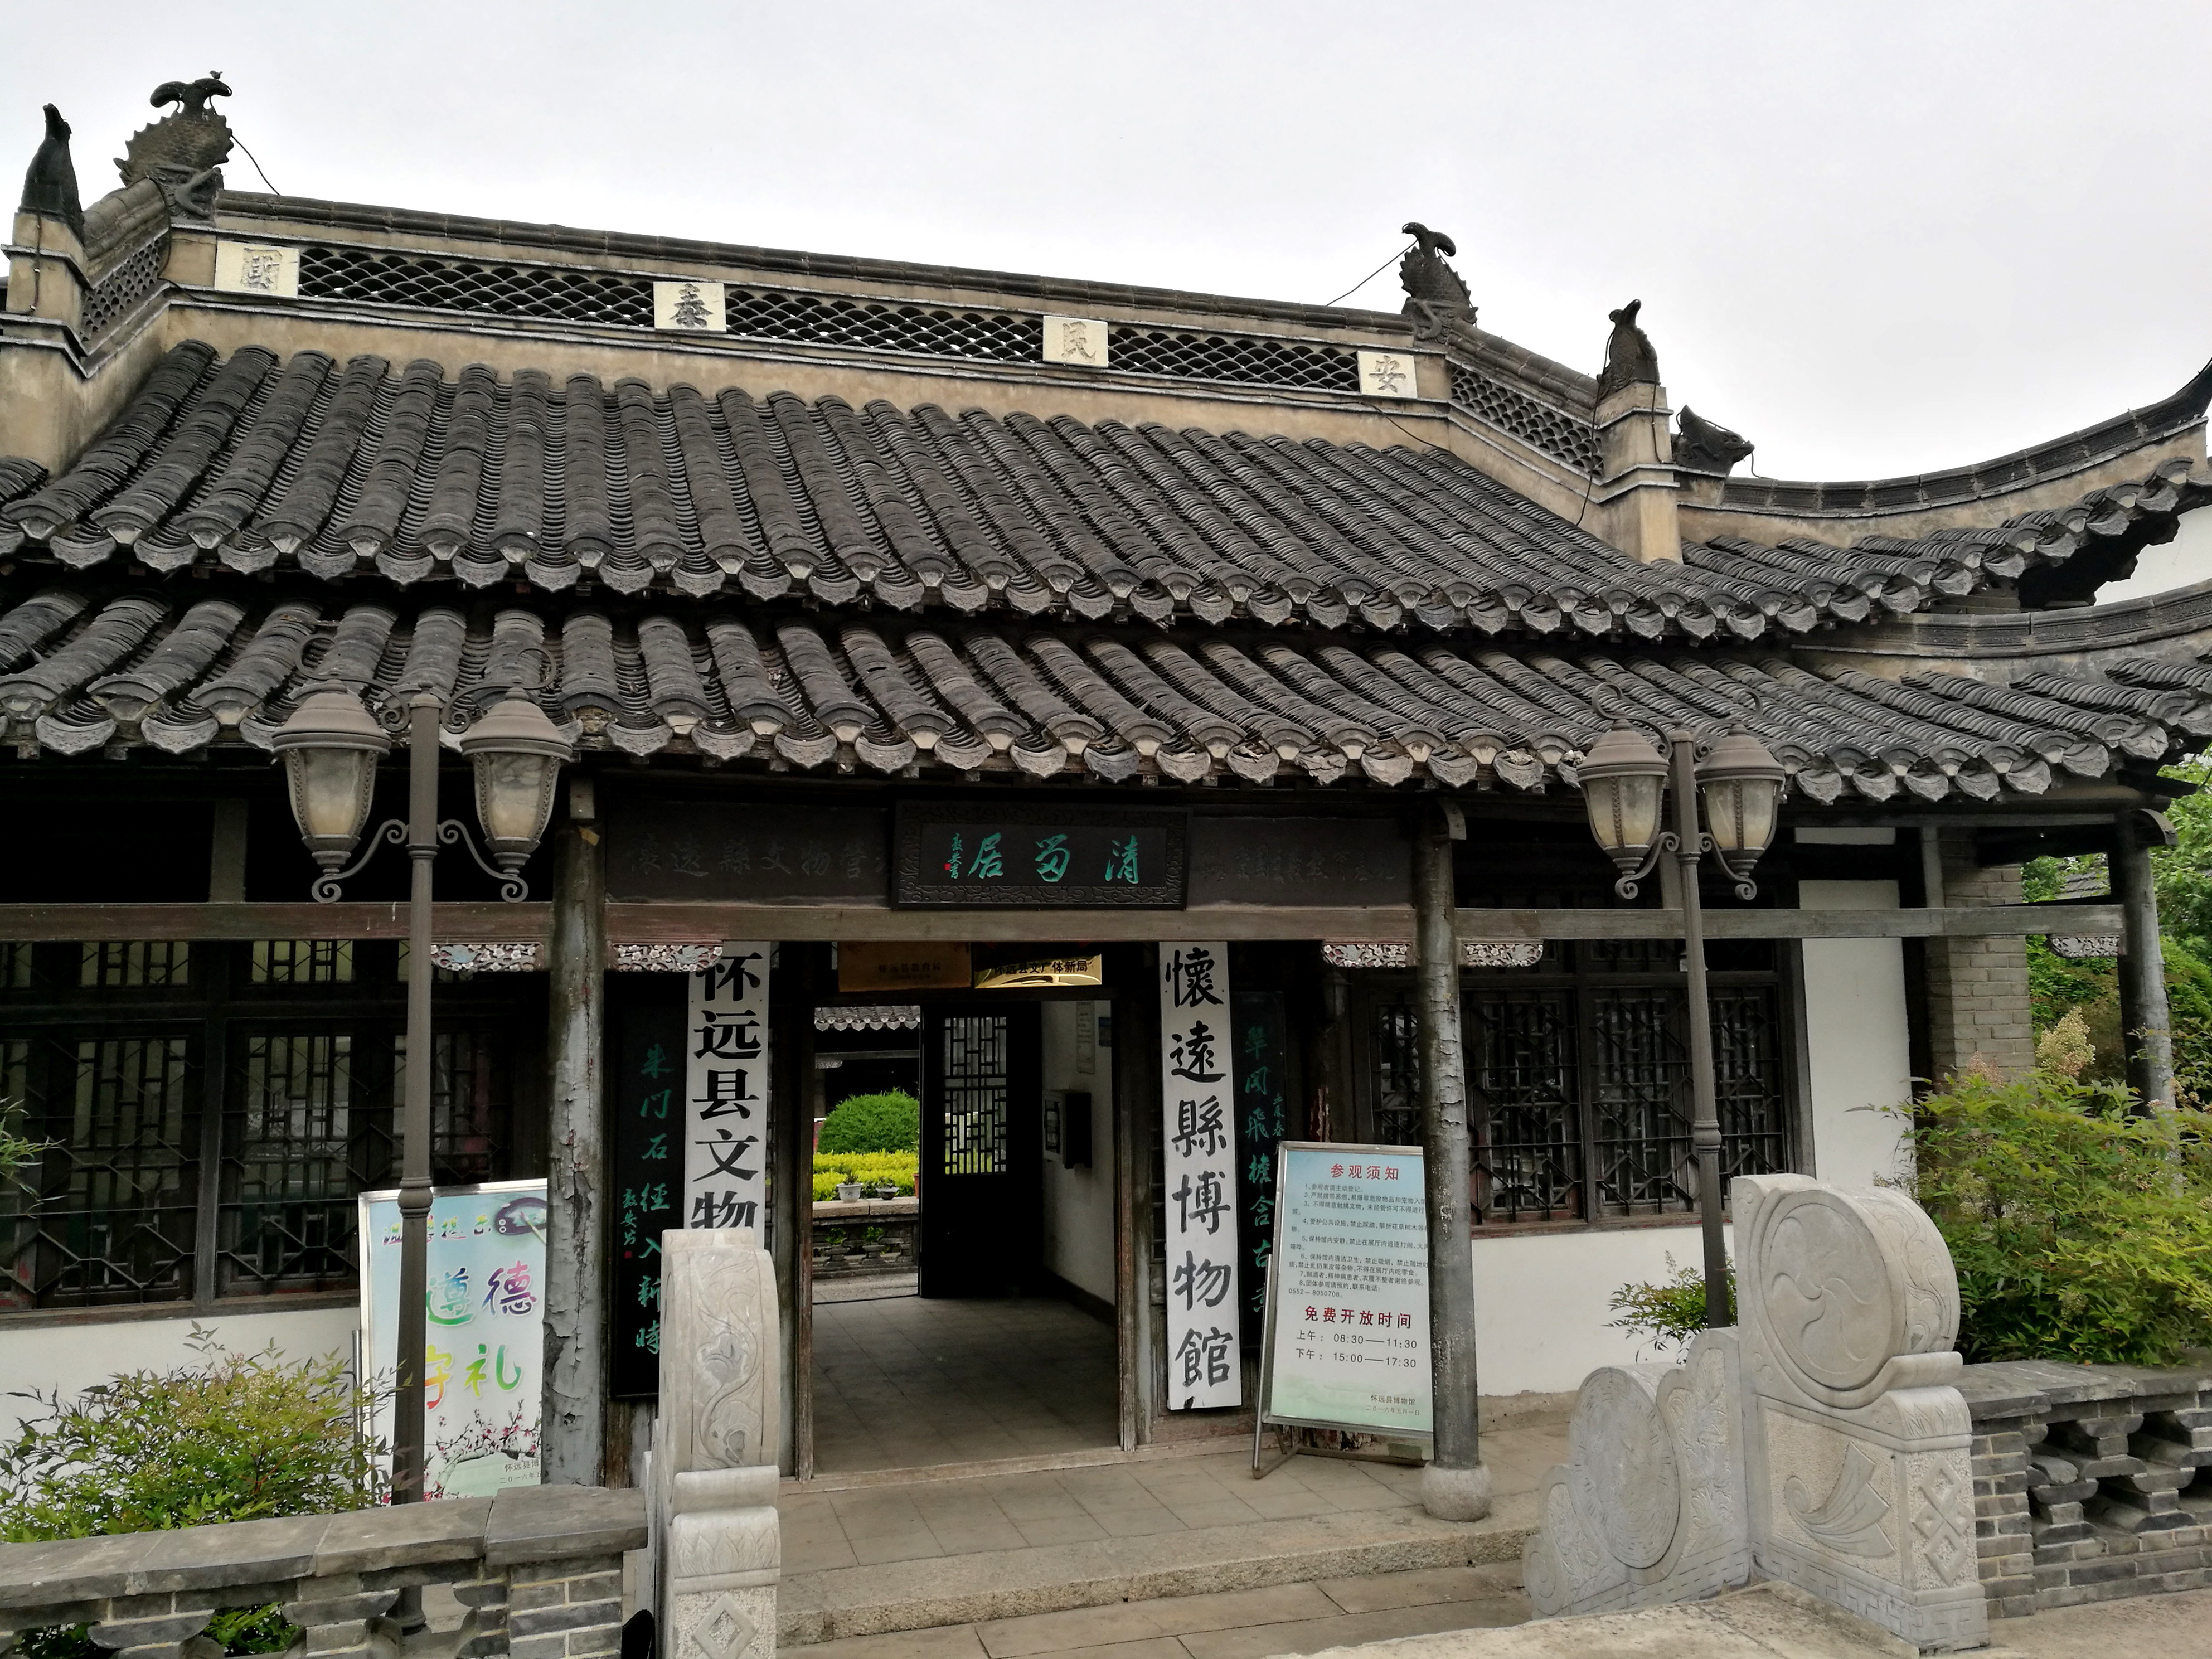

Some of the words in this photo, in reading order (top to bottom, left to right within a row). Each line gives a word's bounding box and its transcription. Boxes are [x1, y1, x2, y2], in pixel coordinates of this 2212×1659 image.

[1062, 321, 1096, 363] 民
[1369, 355, 1407, 394] 安
[995, 960, 1088, 975] 怀远县文广体新局
[691, 952, 762, 1228] 怀远县文物
[1166, 947, 1233, 1388] 懷遠縣博物館
[1331, 1163, 1399, 1181] 参观须知
[426, 1260, 537, 1326] 遵德
[1304, 1306, 1411, 1329] 免费开放时间
[425, 1343, 522, 1410] 守礼
[1370, 1395, 1415, 1406] 怀远县博物馆
[505, 1458, 540, 1472] 怀远县博
